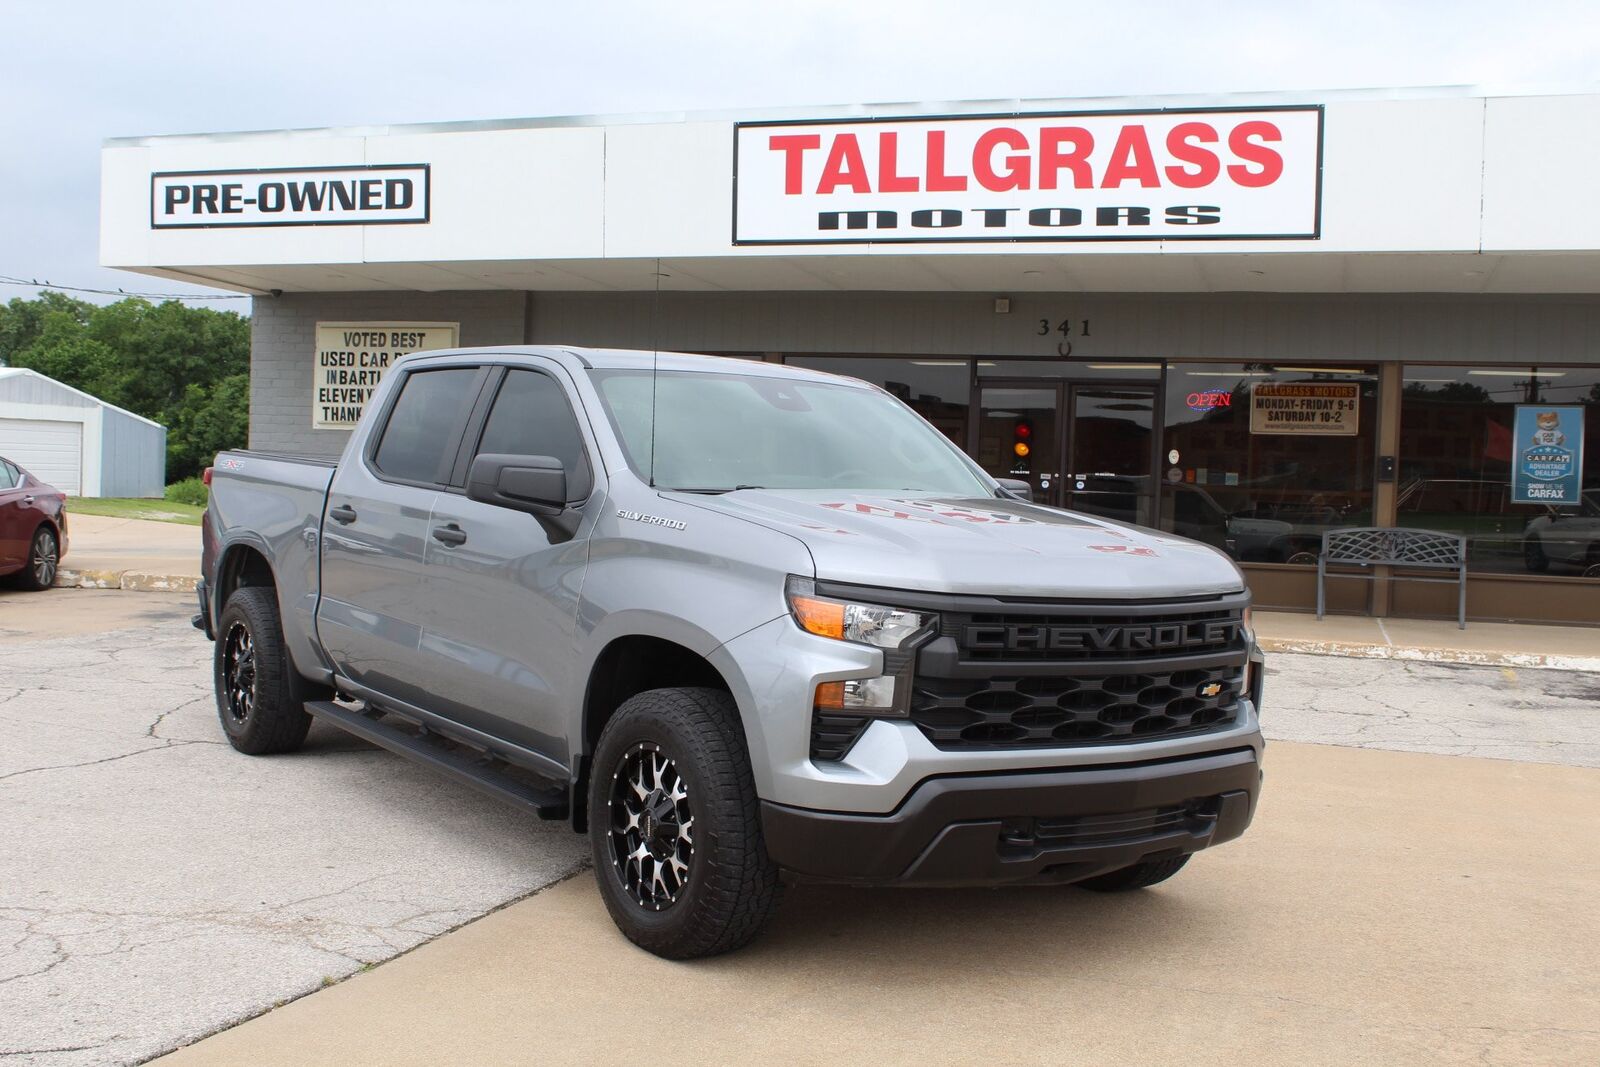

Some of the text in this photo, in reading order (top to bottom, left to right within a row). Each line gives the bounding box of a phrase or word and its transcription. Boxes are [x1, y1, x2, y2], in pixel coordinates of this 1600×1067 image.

[768, 120, 1284, 195] TALLGRASS
[165, 178, 414, 215] PRE-OWNED
[818, 204, 1221, 231] MOTORS
[1038, 319, 1091, 337] 341
[344, 332, 426, 348] VOTED BEST
[321, 351, 355, 367] USED
[360, 352, 388, 367] CAR
[319, 388, 364, 403] ELEVEN
[1257, 385, 1354, 397] TALLGRASS MOTORS
[1186, 392, 1232, 408] OPEN
[1337, 399, 1354, 411] 9-6
[1268, 411, 1342, 423] SATURDAY 10-2
[1528, 489, 1564, 498] CARFAX
[616, 509, 688, 531] SILVERADO
